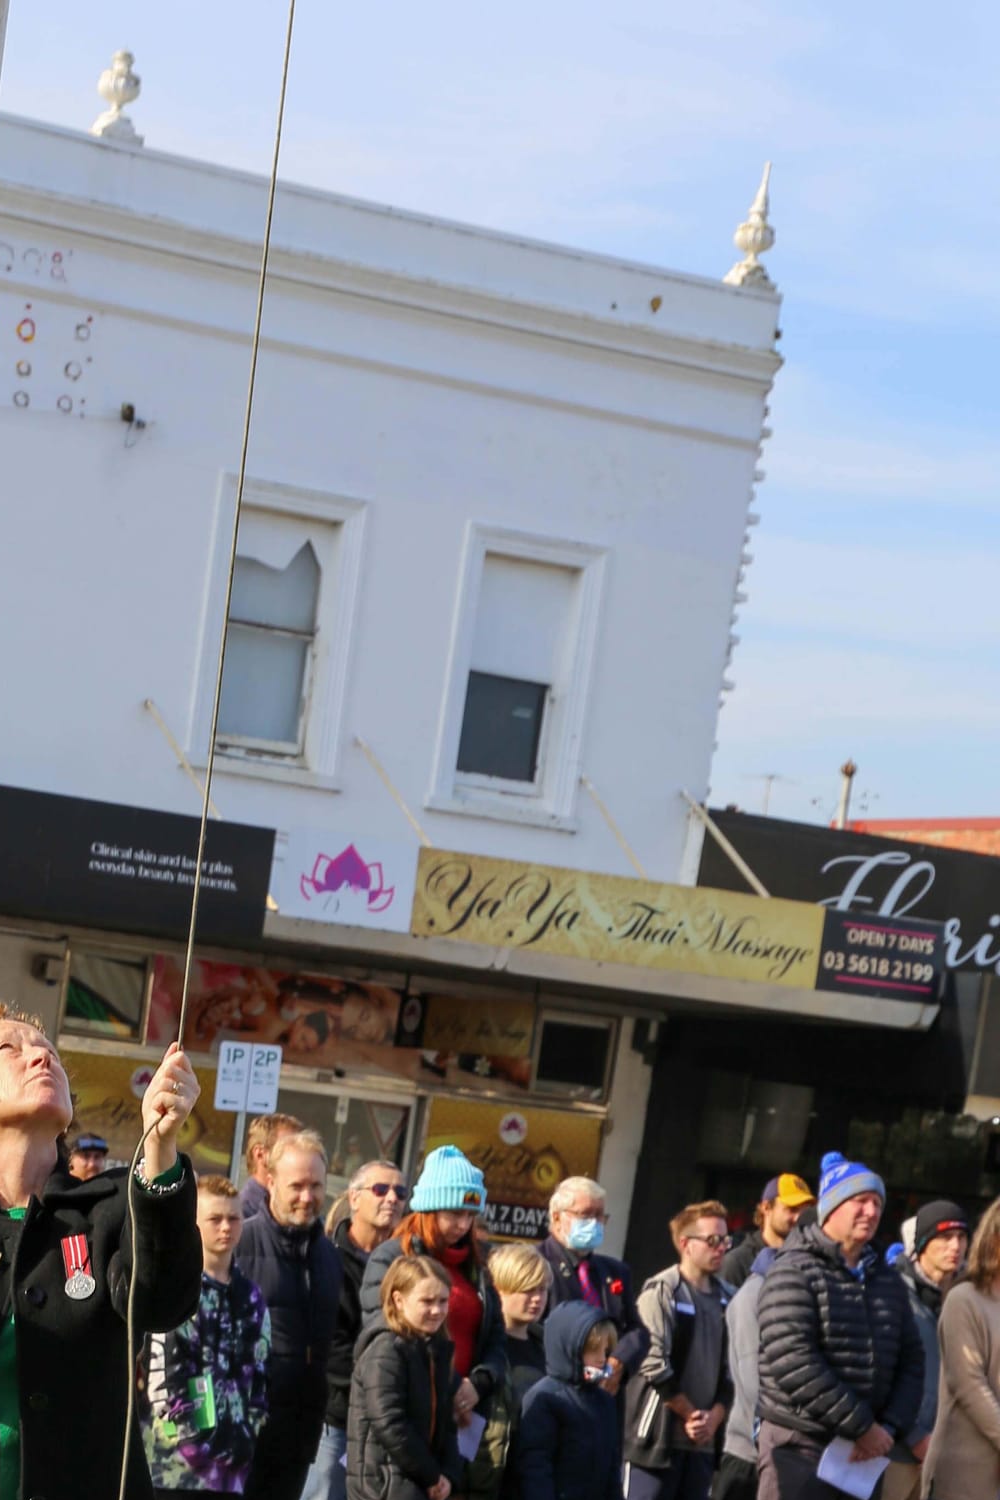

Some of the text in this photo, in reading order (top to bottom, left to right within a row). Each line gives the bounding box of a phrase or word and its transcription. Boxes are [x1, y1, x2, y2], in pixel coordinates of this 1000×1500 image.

[607, 901, 684, 945] Thai
[684, 906, 814, 979] Massage
[846, 929, 935, 955] OPEN 7 DAYS
[823, 951, 934, 982] 03 5618 2199
[226, 1047, 245, 1064] 1P
[255, 1050, 278, 1067] 2P
